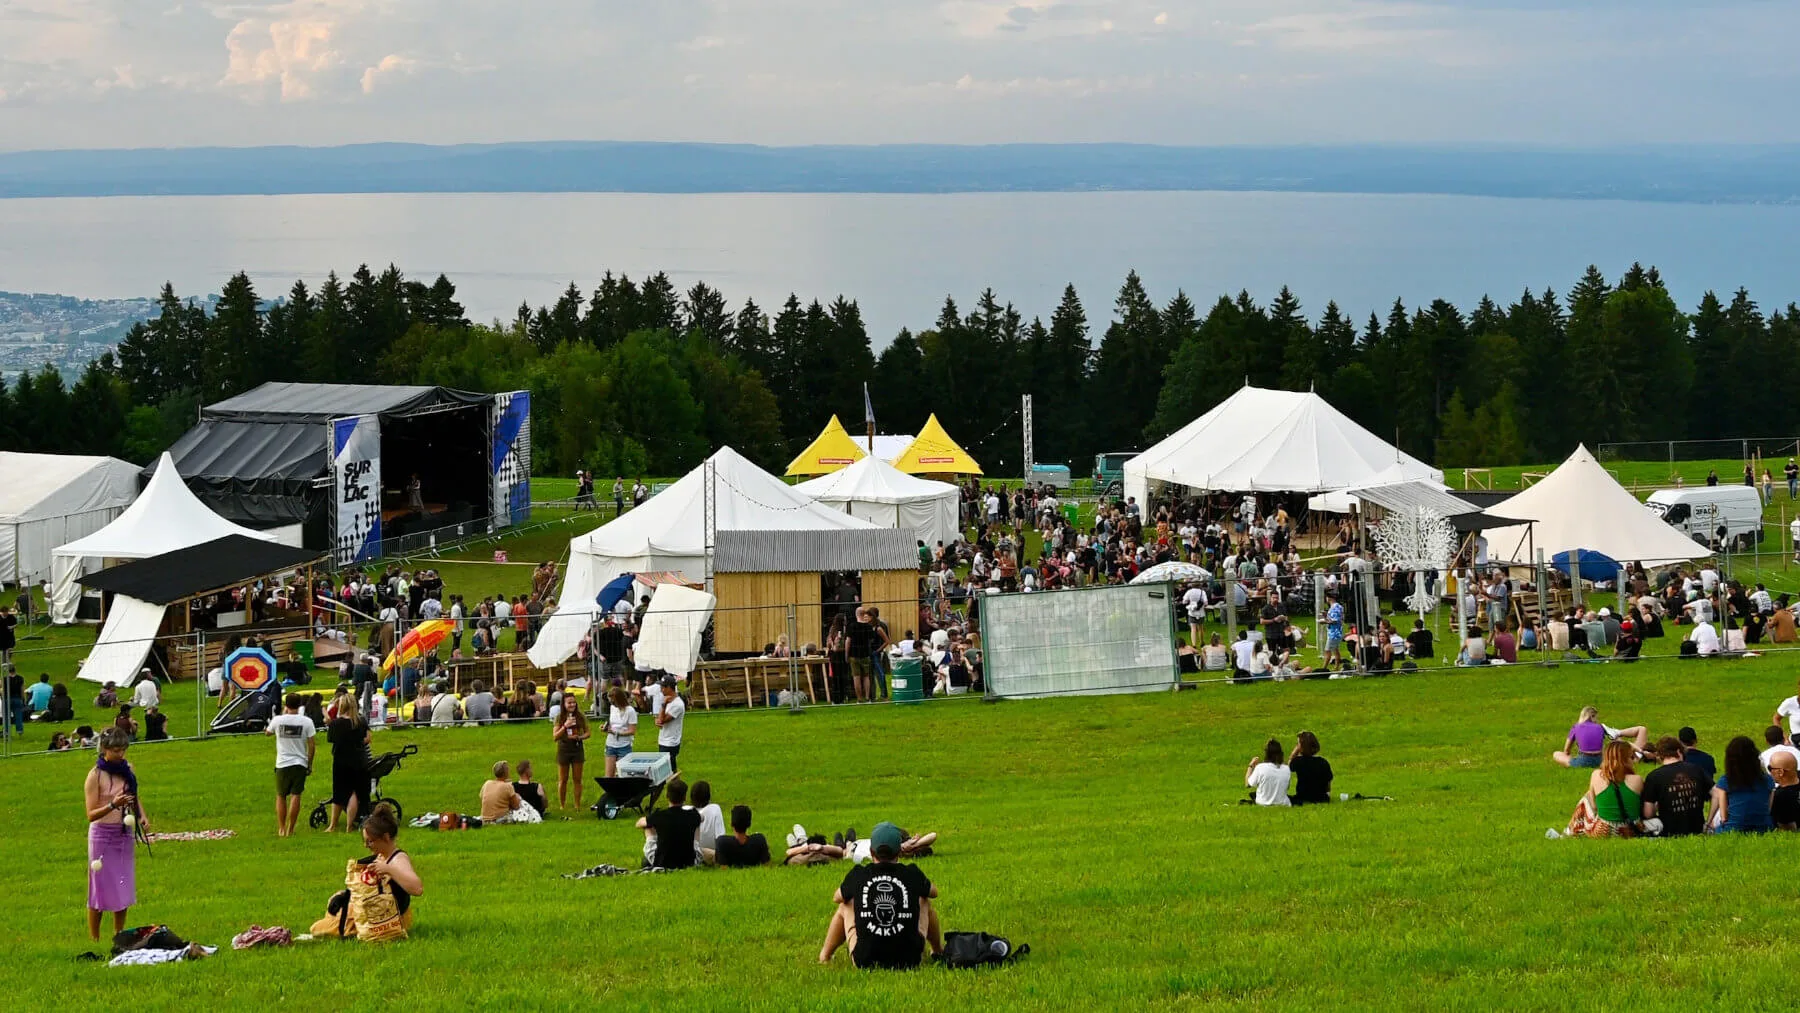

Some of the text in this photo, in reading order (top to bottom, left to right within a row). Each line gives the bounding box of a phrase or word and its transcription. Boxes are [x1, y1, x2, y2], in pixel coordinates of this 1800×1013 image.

[345, 460, 371, 474] SUR
[344, 470, 360, 489] LE
[344, 485, 369, 503] LAC
[866, 921, 904, 936] MAKIA
